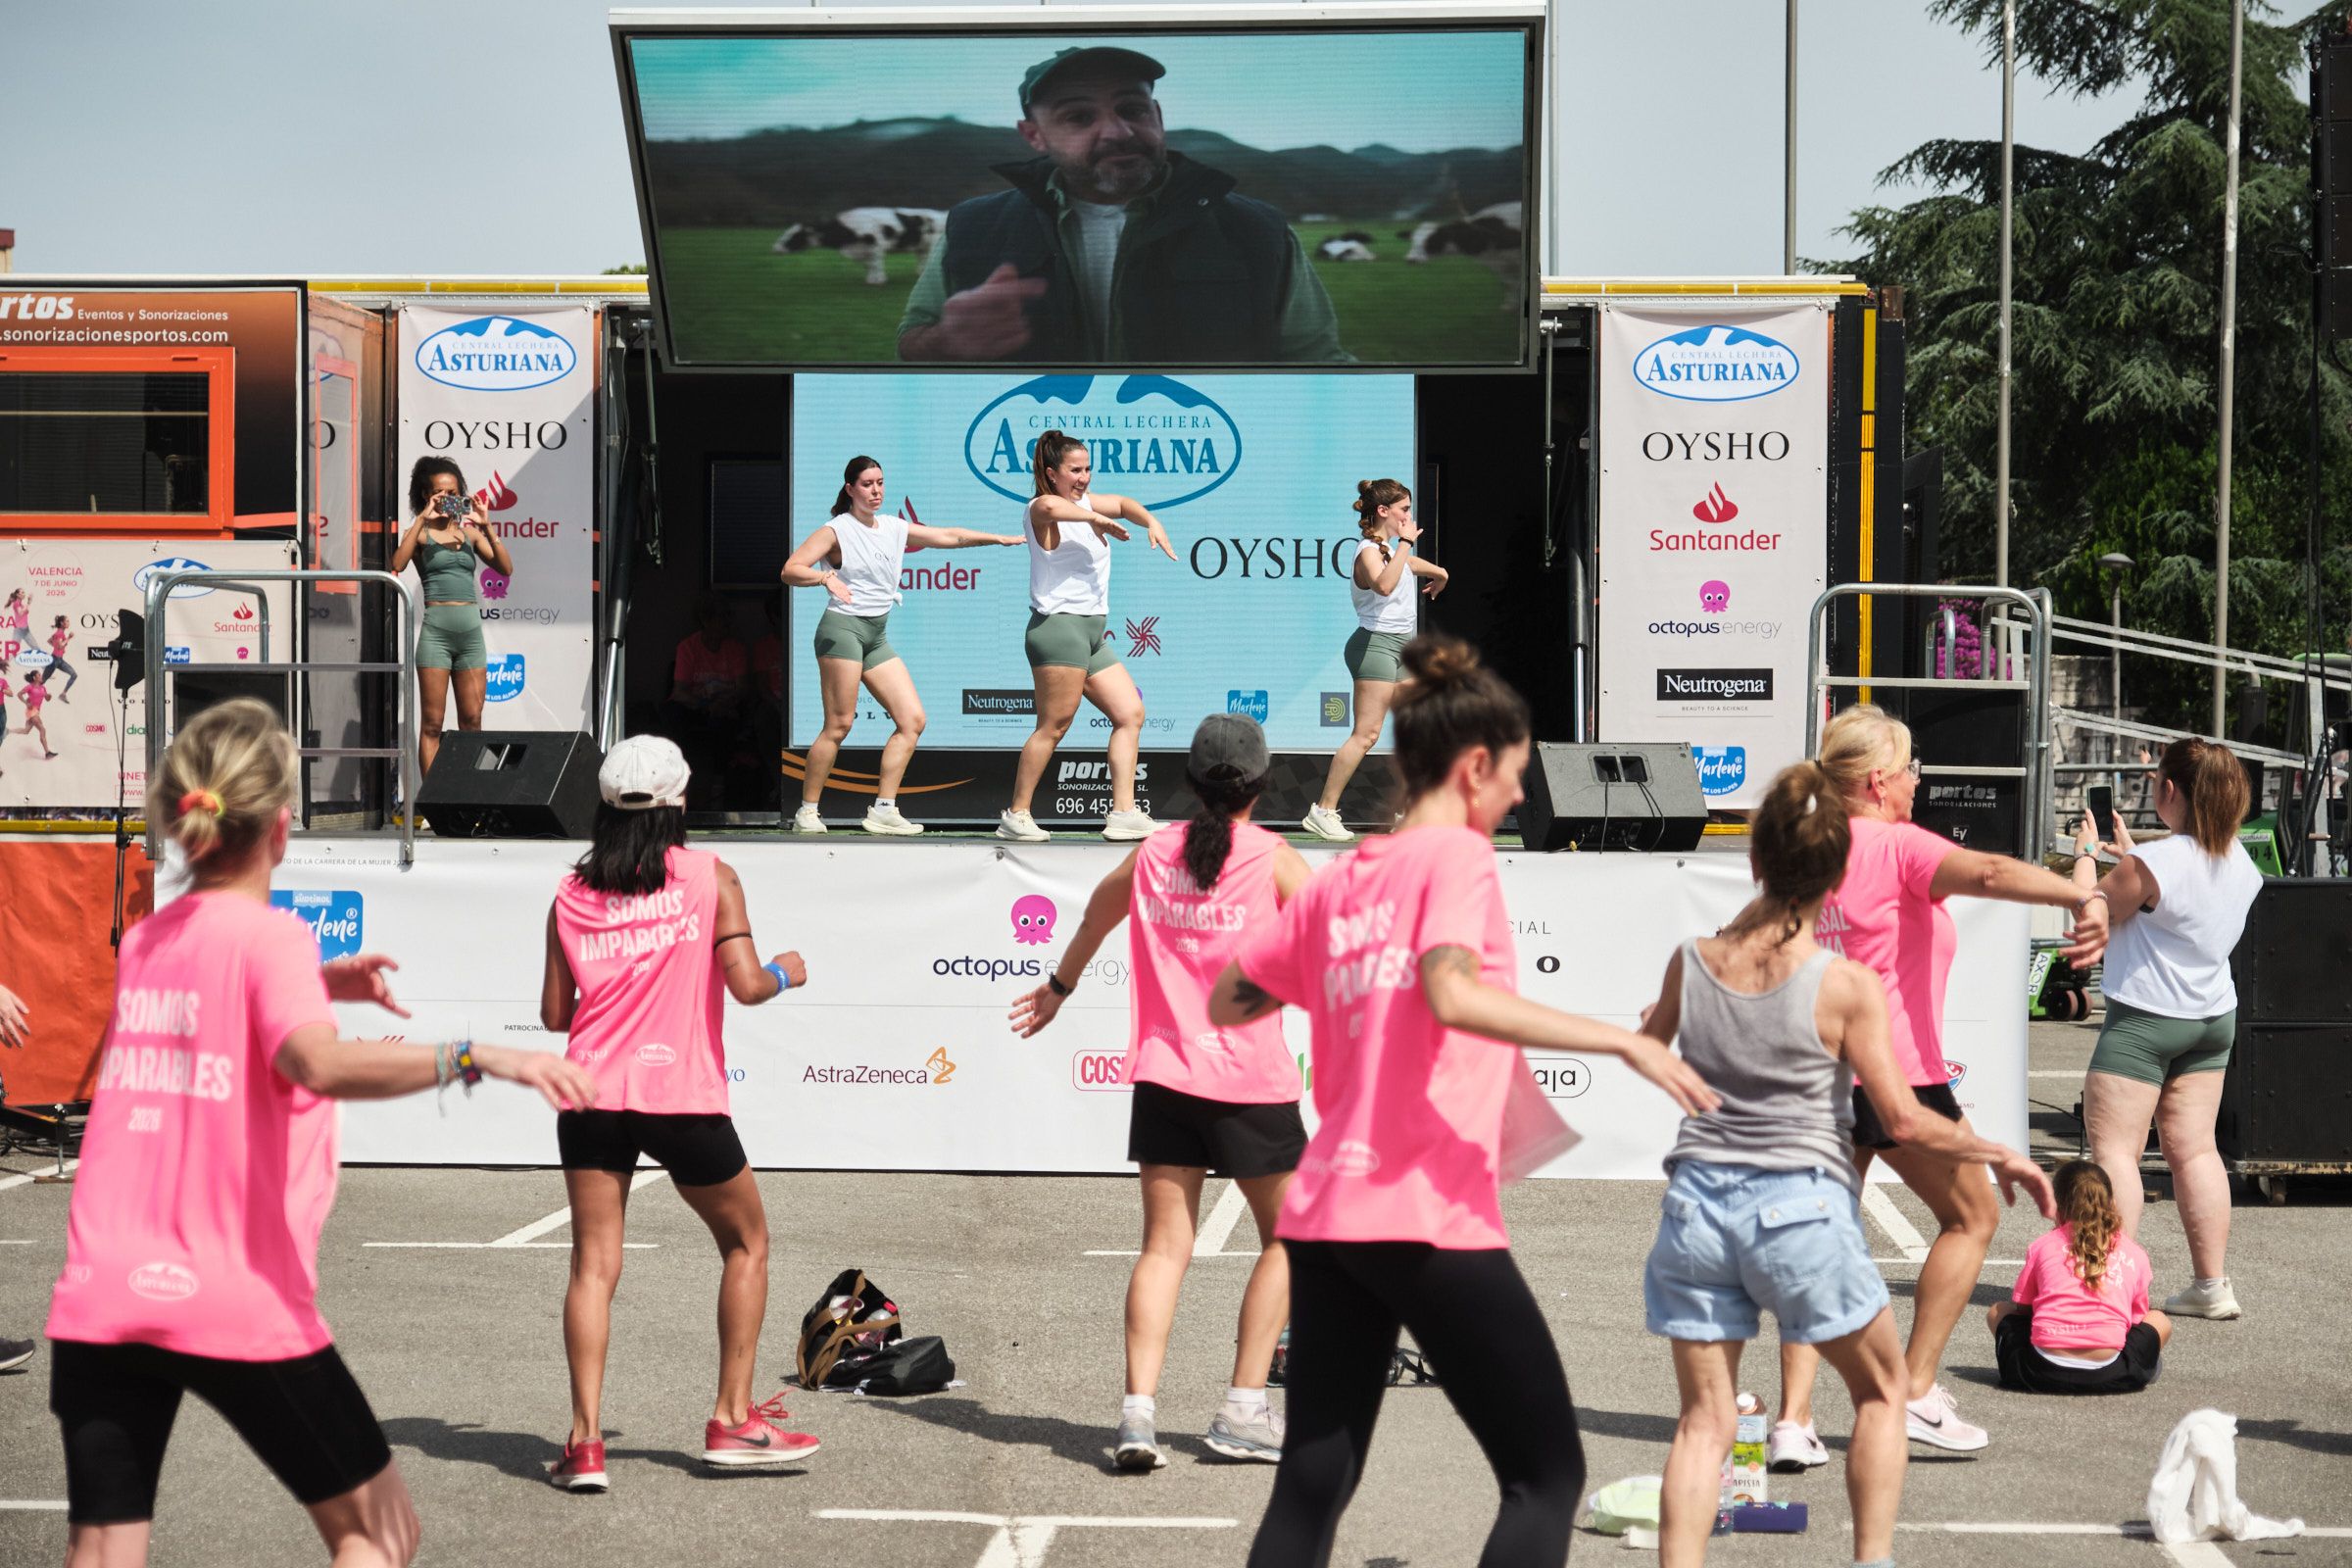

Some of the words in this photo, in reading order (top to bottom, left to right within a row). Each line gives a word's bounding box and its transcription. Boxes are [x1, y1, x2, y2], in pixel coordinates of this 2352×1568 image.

[0, 294, 74, 320] rtos
[78, 310, 123, 319] Eventos
[128, 312, 134, 321] y
[138, 310, 228, 320] Sonorizaciones
[0, 327, 228, 344] .sonorizacionesportos.com
[427, 344, 564, 371] ASTURIANA
[1646, 353, 1788, 381] ASTURIANA
[1029, 415, 1115, 429] CENTRAL
[1124, 415, 1212, 429] LECHERA
[424, 420, 567, 450] OYSHO
[1642, 431, 1790, 462] OYSHO
[1649, 529, 1782, 551] Santander
[28, 567, 83, 576] VALENCIA
[899, 562, 982, 590] ander
[80, 613, 120, 628] OYS
[502, 608, 561, 625] energy
[1648, 620, 1720, 638] octopus
[1722, 621, 1783, 639] energy
[486, 663, 523, 686] arlene
[1664, 674, 1766, 698] Neutrogena
[968, 694, 1034, 711] Neutrogena
[1144, 718, 1176, 732] nergy
[1057, 761, 1149, 782] pors
[1929, 785, 1997, 800] portos
[1055, 798, 1085, 814] 696
[1952, 827, 1968, 841] EV
[605, 889, 684, 924] SOMOS
[307, 907, 358, 944] rlene
[1820, 905, 1852, 934] SAL
[932, 956, 1041, 982] octopus
[1045, 959, 1131, 985] ergy
[2029, 954, 2048, 994] AXOR
[115, 988, 202, 1037] SOMOS
[99, 1046, 234, 1102] PARABLES
[803, 1065, 928, 1084] AstraZeneca
[1081, 1055, 1123, 1084] COS
